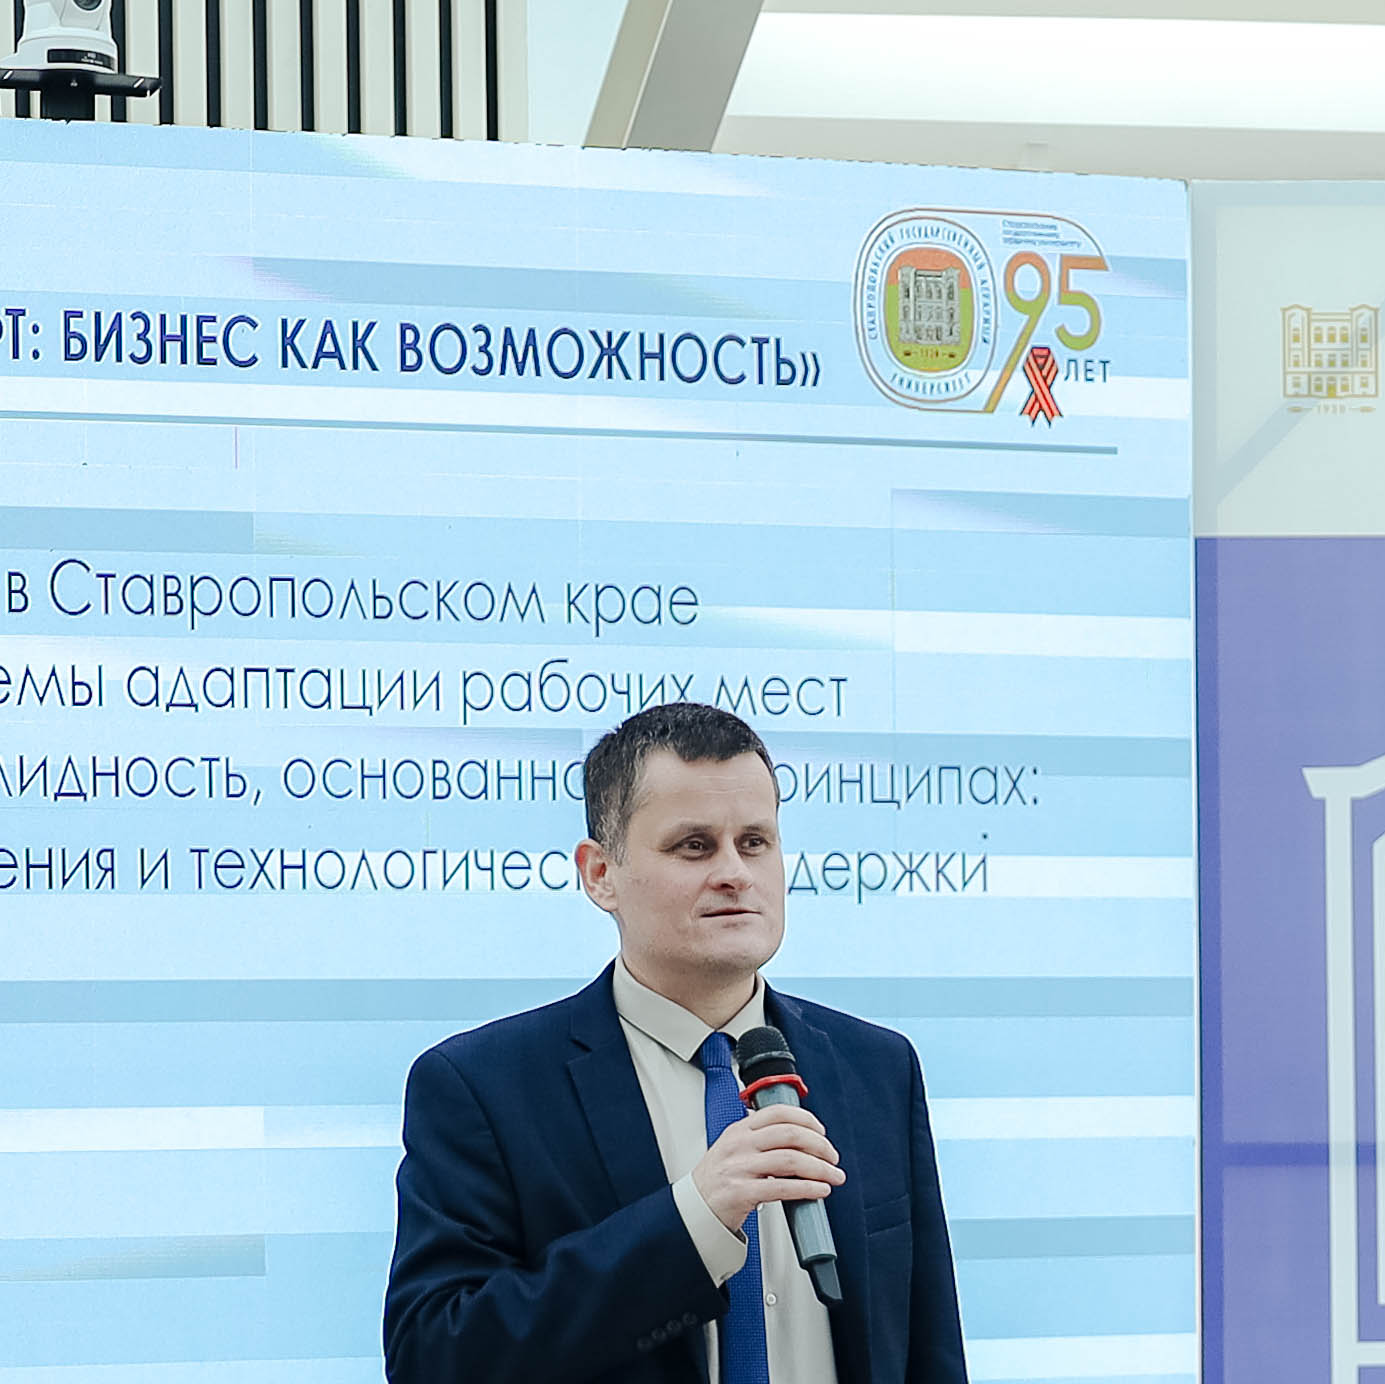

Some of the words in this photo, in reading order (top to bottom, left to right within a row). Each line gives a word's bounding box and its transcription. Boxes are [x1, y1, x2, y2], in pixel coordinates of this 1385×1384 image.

[62, 310, 259, 369] БИЗНЕС
[280, 318, 380, 373] КАК
[399, 322, 821, 388] ВОЗМОЖНОСТЬ»
[1064, 358, 1111, 384] ЛЕТ
[6, 571, 30, 613] в
[49, 558, 545, 631] Ставропольском
[567, 583, 700, 637] крае
[126, 665, 441, 717] адаптации
[461, 658, 694, 723] рабочих
[715, 676, 848, 717] мест
[283, 758, 583, 801] основанно
[140, 847, 169, 890] и
[189, 848, 580, 891] технологичес
[788, 851, 988, 905] держки
